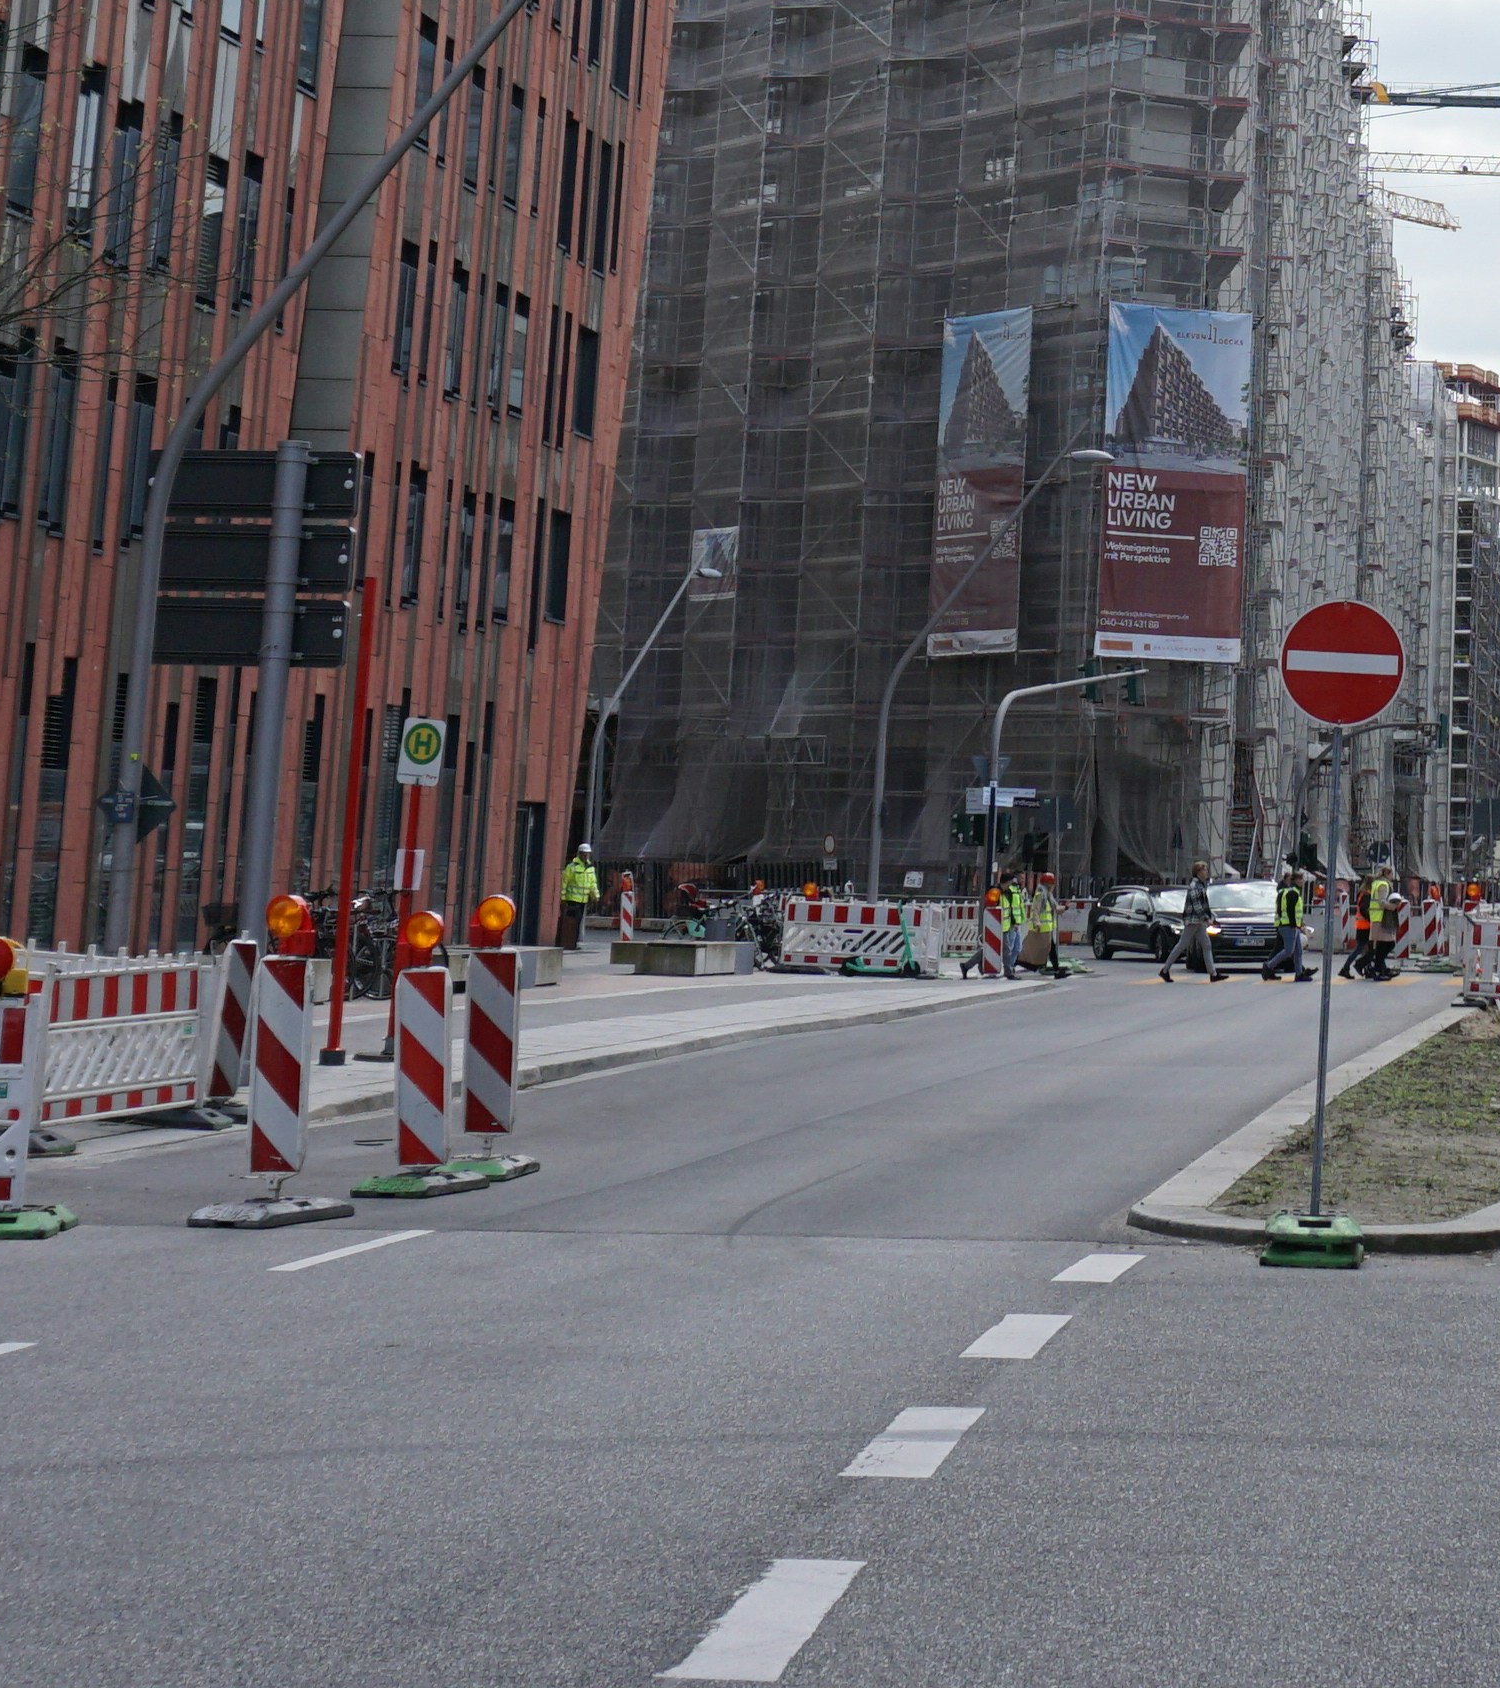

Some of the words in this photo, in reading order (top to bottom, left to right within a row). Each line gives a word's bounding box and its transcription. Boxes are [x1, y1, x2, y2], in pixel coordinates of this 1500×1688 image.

[1176, 332, 1207, 340] ELEVEN
[1218, 338, 1244, 346] DECKS
[939, 478, 966, 496] NEW
[1108, 472, 1157, 491] NEW
[938, 494, 975, 513] URBAN
[1108, 490, 1176, 511] URBAN
[937, 512, 973, 531] LIVING
[1107, 508, 1172, 529] LIVING
[1105, 541, 1169, 554] Wohneigentum
[1104, 552, 1118, 561] mit
[1120, 552, 1170, 564] Perspektive
[413, 732, 432, 755] H
